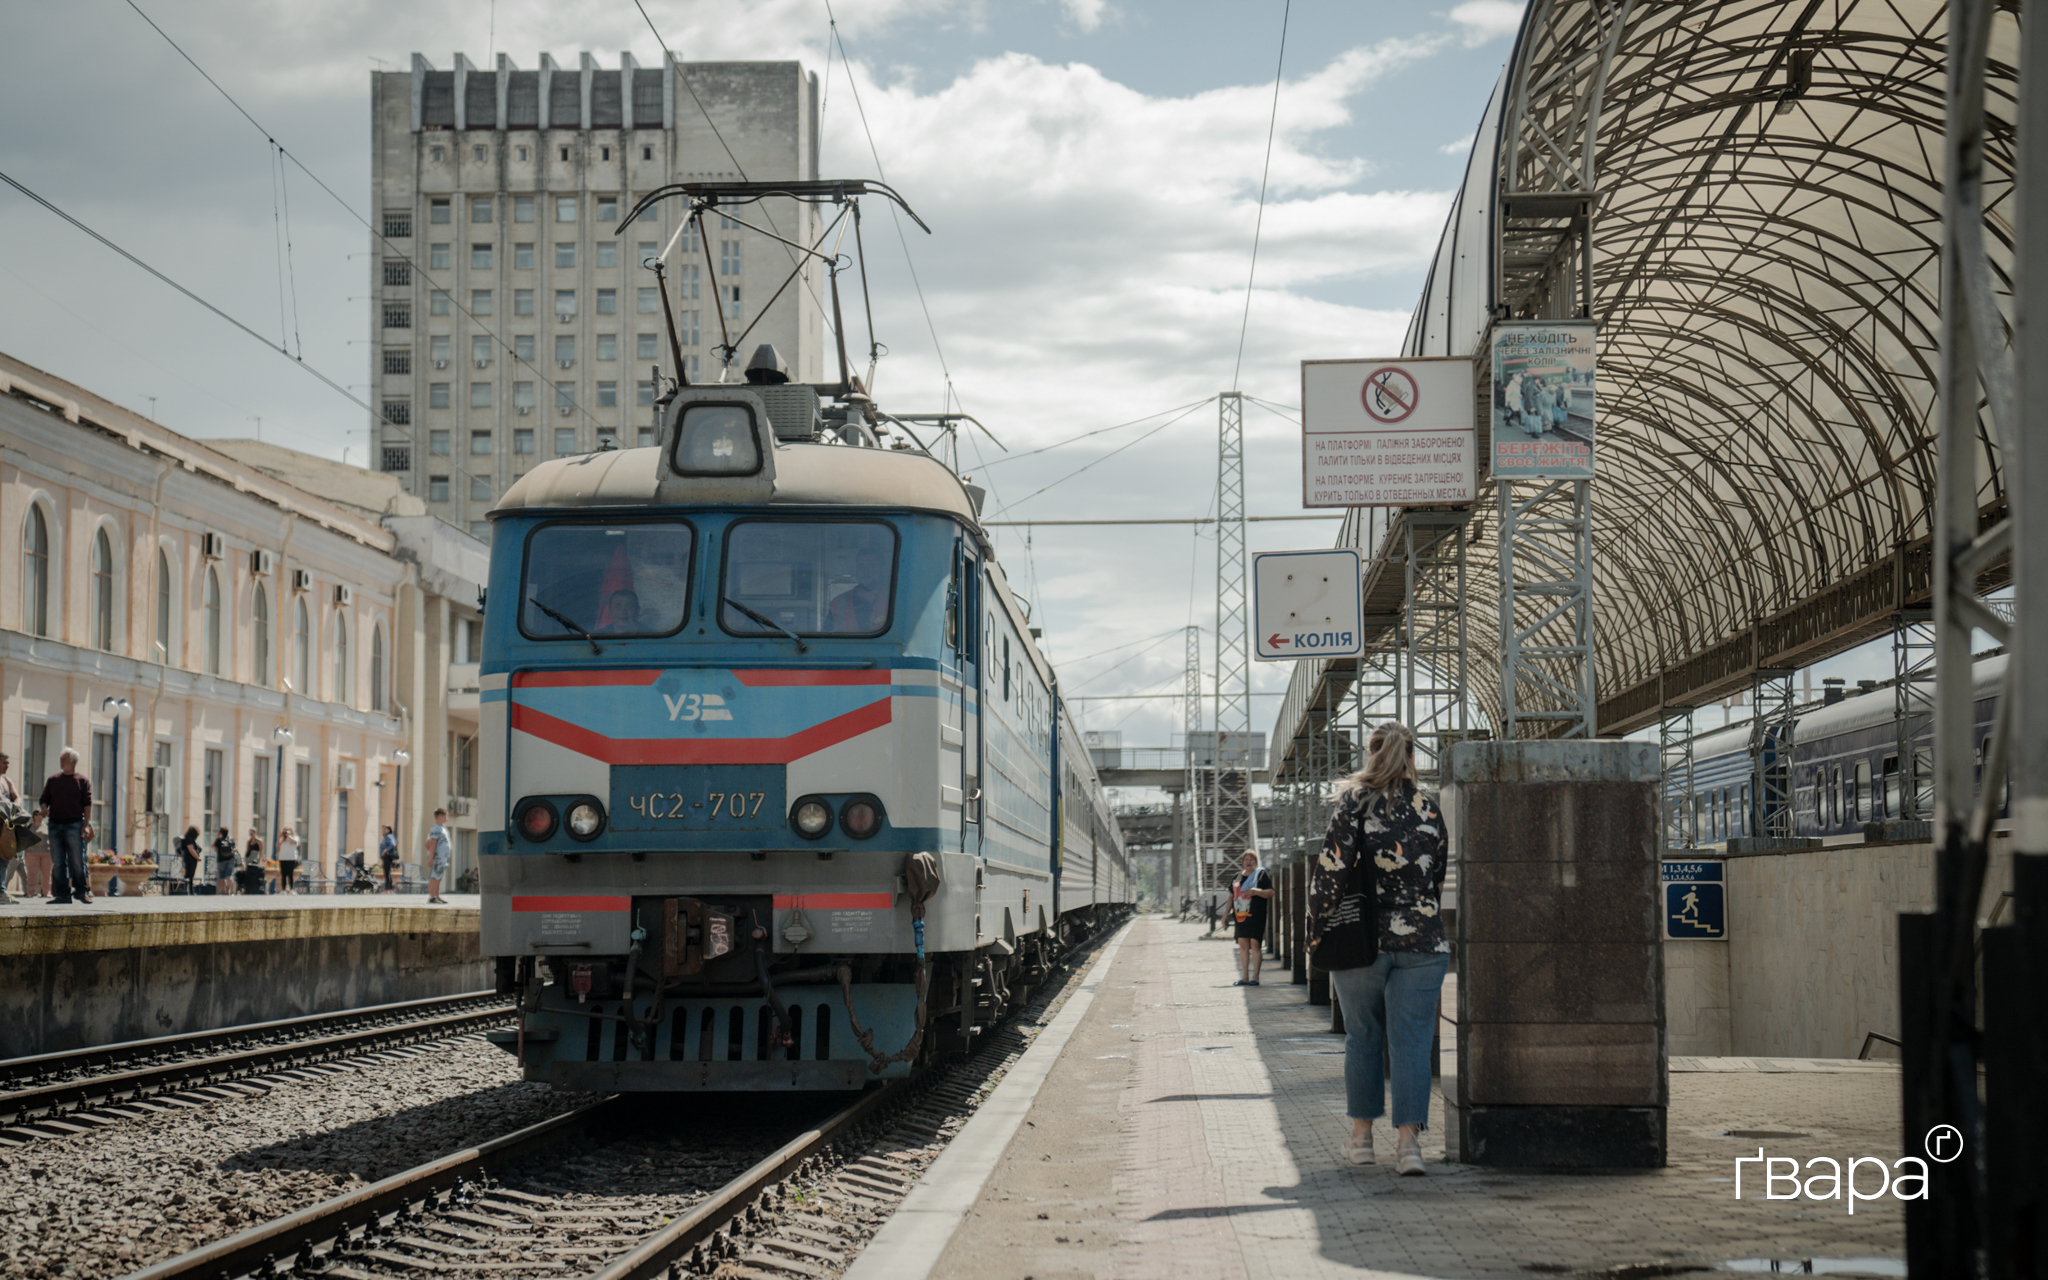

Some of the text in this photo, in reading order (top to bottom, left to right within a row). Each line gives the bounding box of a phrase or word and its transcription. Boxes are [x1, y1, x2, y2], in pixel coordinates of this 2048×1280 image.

[1507, 333, 1577, 344] НЕ ХОДІТЬ
[1498, 347, 1529, 355] ЧЕРЕЗ
[1316, 437, 1465, 450] НА ПЛАТФОРМІ ПАЛІННЯ ЗАБОРОНЕНО!
[1497, 442, 1590, 455] БЕРЕЖІТЬ
[1318, 453, 1461, 466] ПАЛИТИ ТІЛЬКИ В ВІДВЕДЕНИХ МІСЦЯХ
[1498, 457, 1589, 467] СВОЄ ЖИТТЯ!
[1316, 473, 1463, 485] НА ПЛАТФОРМЕ КУРЕНИЕ ЗАПРЕЩЕНО!
[1315, 488, 1467, 502] КУРИТЬ ТОЛЬКО В ОТВЕДЕННЫХ МЕСТАХ
[1295, 632, 1352, 648] КОЛІЯ
[630, 793, 765, 819] ЧС2-707
[1670, 865, 1702, 874] 1,3,4,5,6
